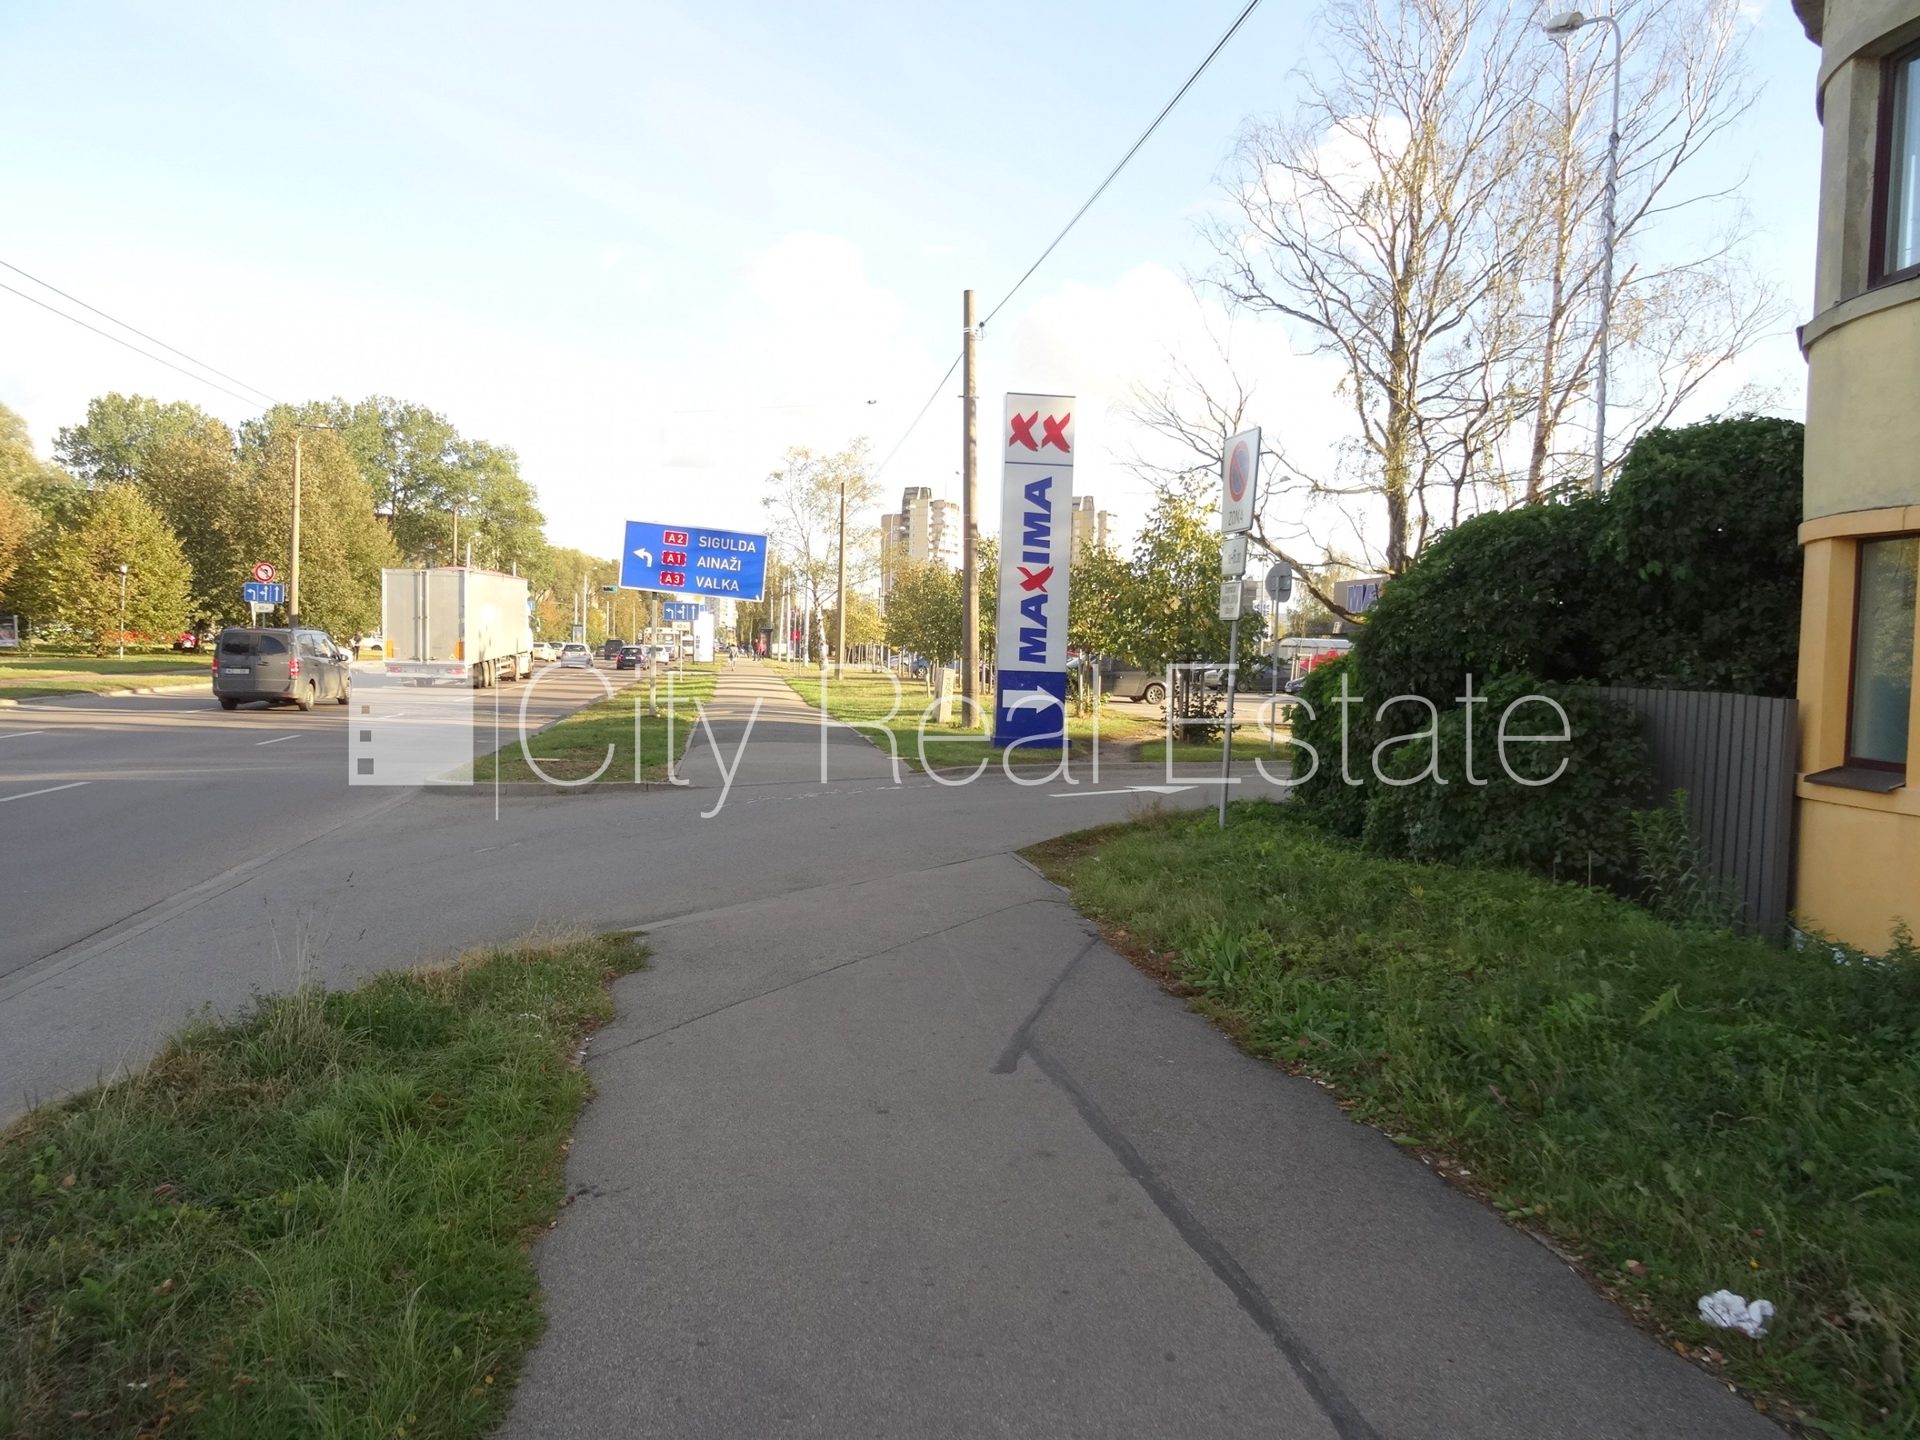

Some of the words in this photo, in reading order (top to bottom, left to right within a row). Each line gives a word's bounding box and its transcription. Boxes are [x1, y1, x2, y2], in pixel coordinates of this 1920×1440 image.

[668, 533, 684, 544] A2
[698, 535, 756, 553] SIGULDA
[666, 554, 682, 564] A1
[696, 556, 741, 572] AINAŽI
[1017, 476, 1055, 664] MAXIMA
[664, 575, 680, 585] A3
[695, 575, 740, 592] VALKA
